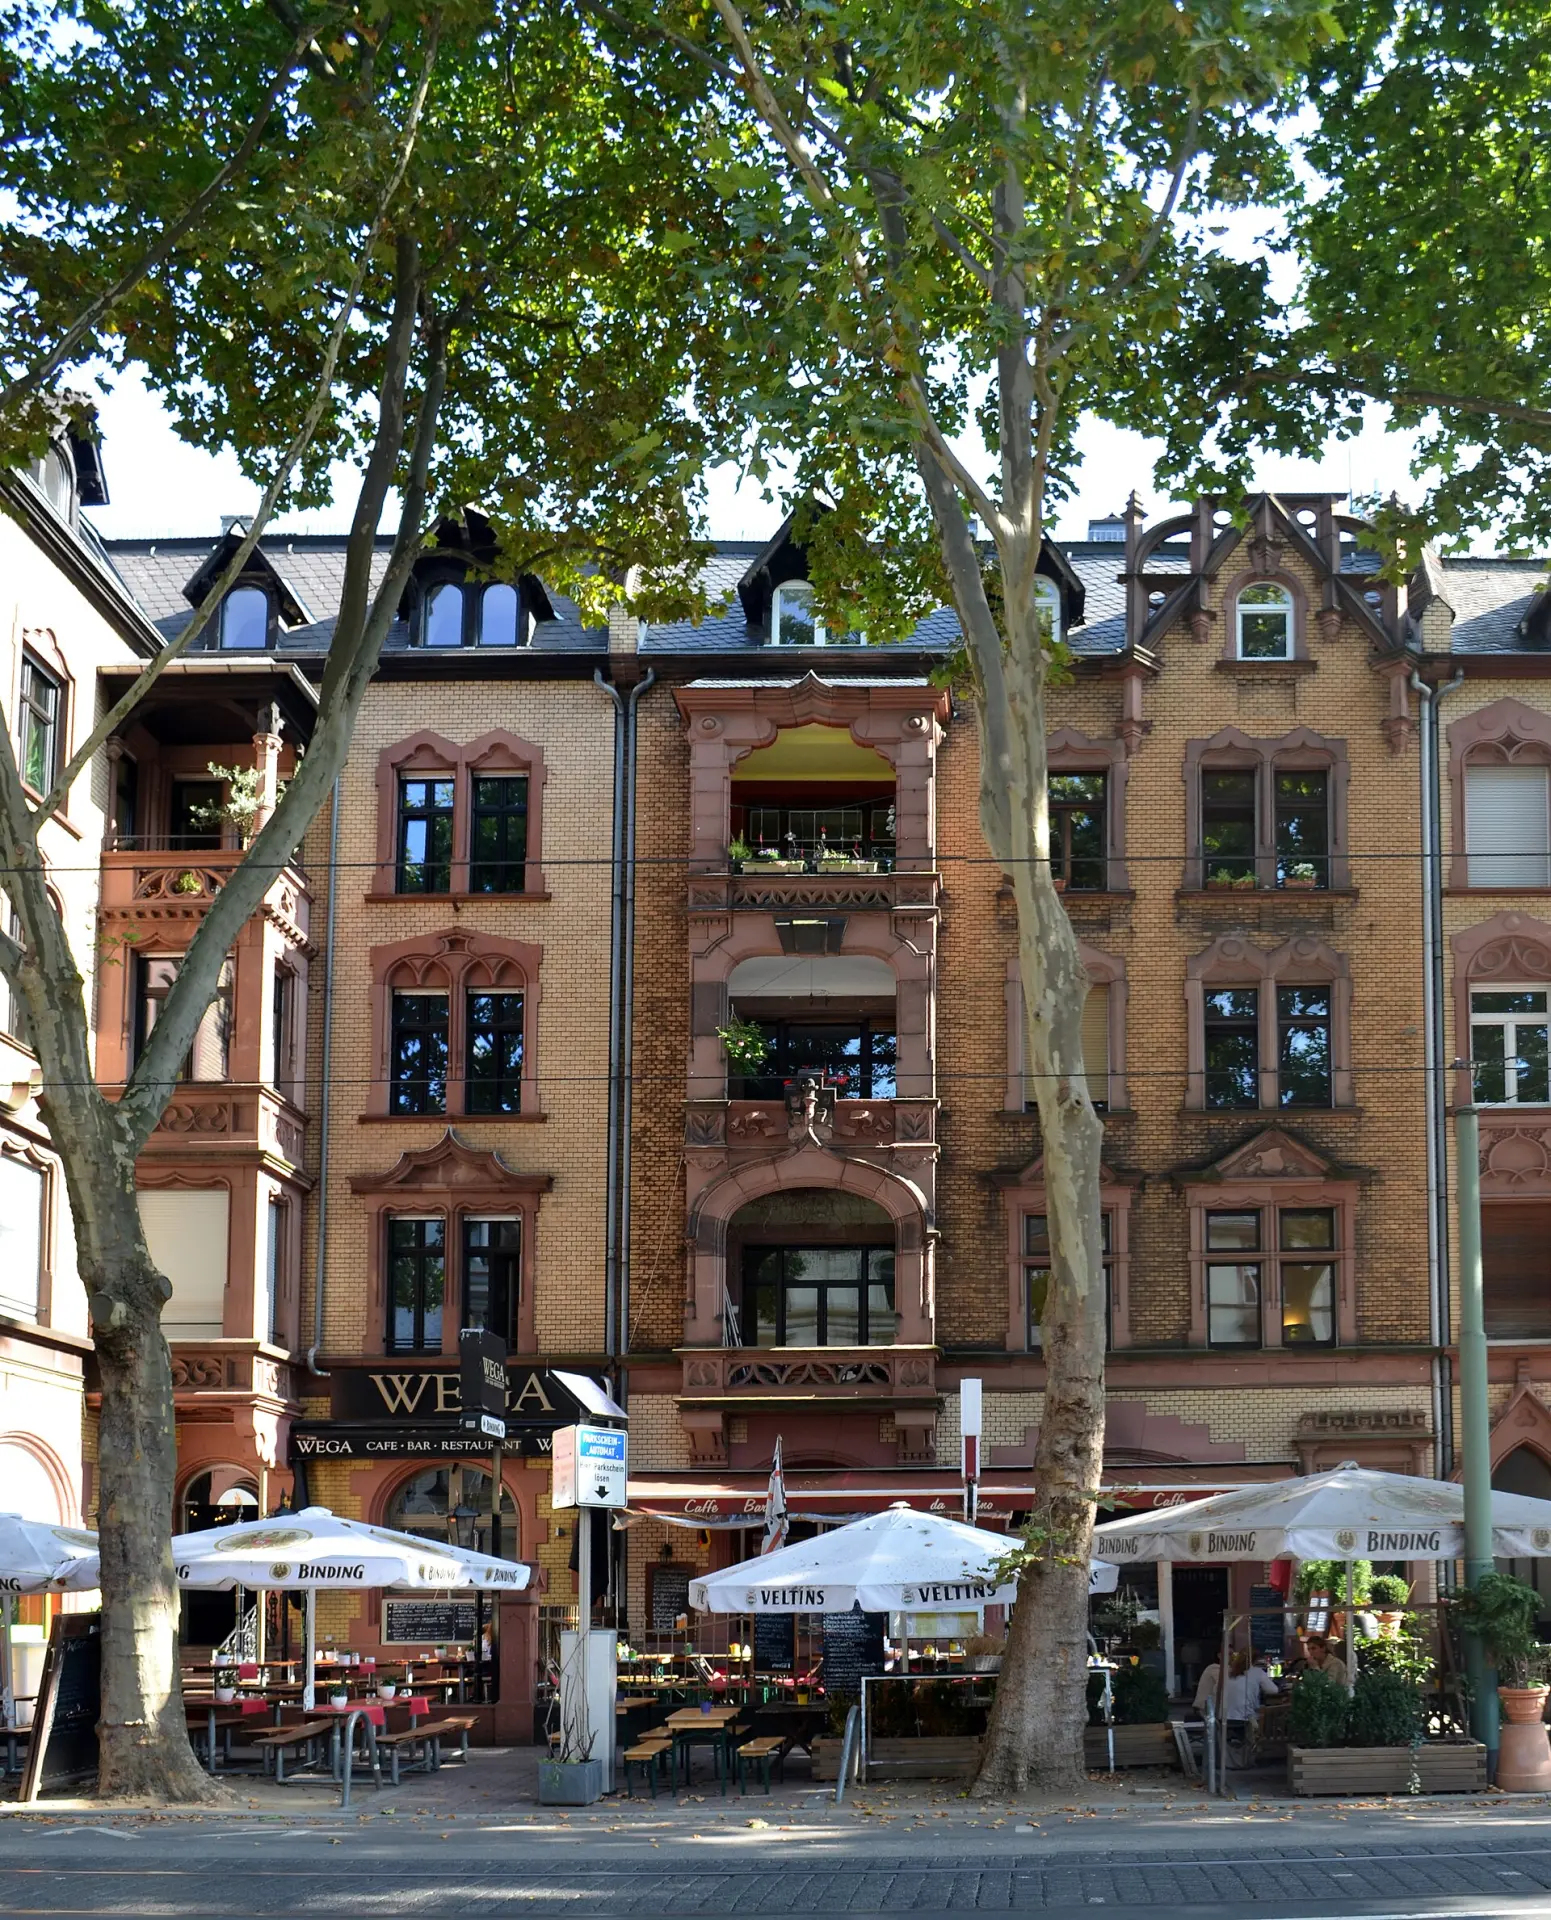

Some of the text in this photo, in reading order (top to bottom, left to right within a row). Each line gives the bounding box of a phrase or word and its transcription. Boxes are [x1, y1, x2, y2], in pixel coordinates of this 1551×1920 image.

[482, 1356, 505, 1382] WEGA
[368, 1373, 557, 1413] WEA
[296, 1440, 522, 1454] WEGA CAFE BAR RESTAURNT
[588, 1445, 615, 1456] AUTOMAT
[594, 1462, 625, 1473] Parkschein
[594, 1472, 610, 1483] lösen
[684, 1499, 719, 1513] Caffe
[743, 1499, 767, 1513] Bar
[929, 1498, 946, 1510] da
[1153, 1492, 1187, 1507] Caffe
[1098, 1536, 1139, 1555] BINDING
[1208, 1531, 1257, 1553] BINDING
[1367, 1530, 1440, 1552] BINDING
[298, 1564, 365, 1580] BINDING
[428, 1566, 456, 1580] BINDING
[493, 1568, 518, 1583] BINDING
[760, 1589, 826, 1606] VELTINS
[918, 1582, 997, 1603] VELTINS
